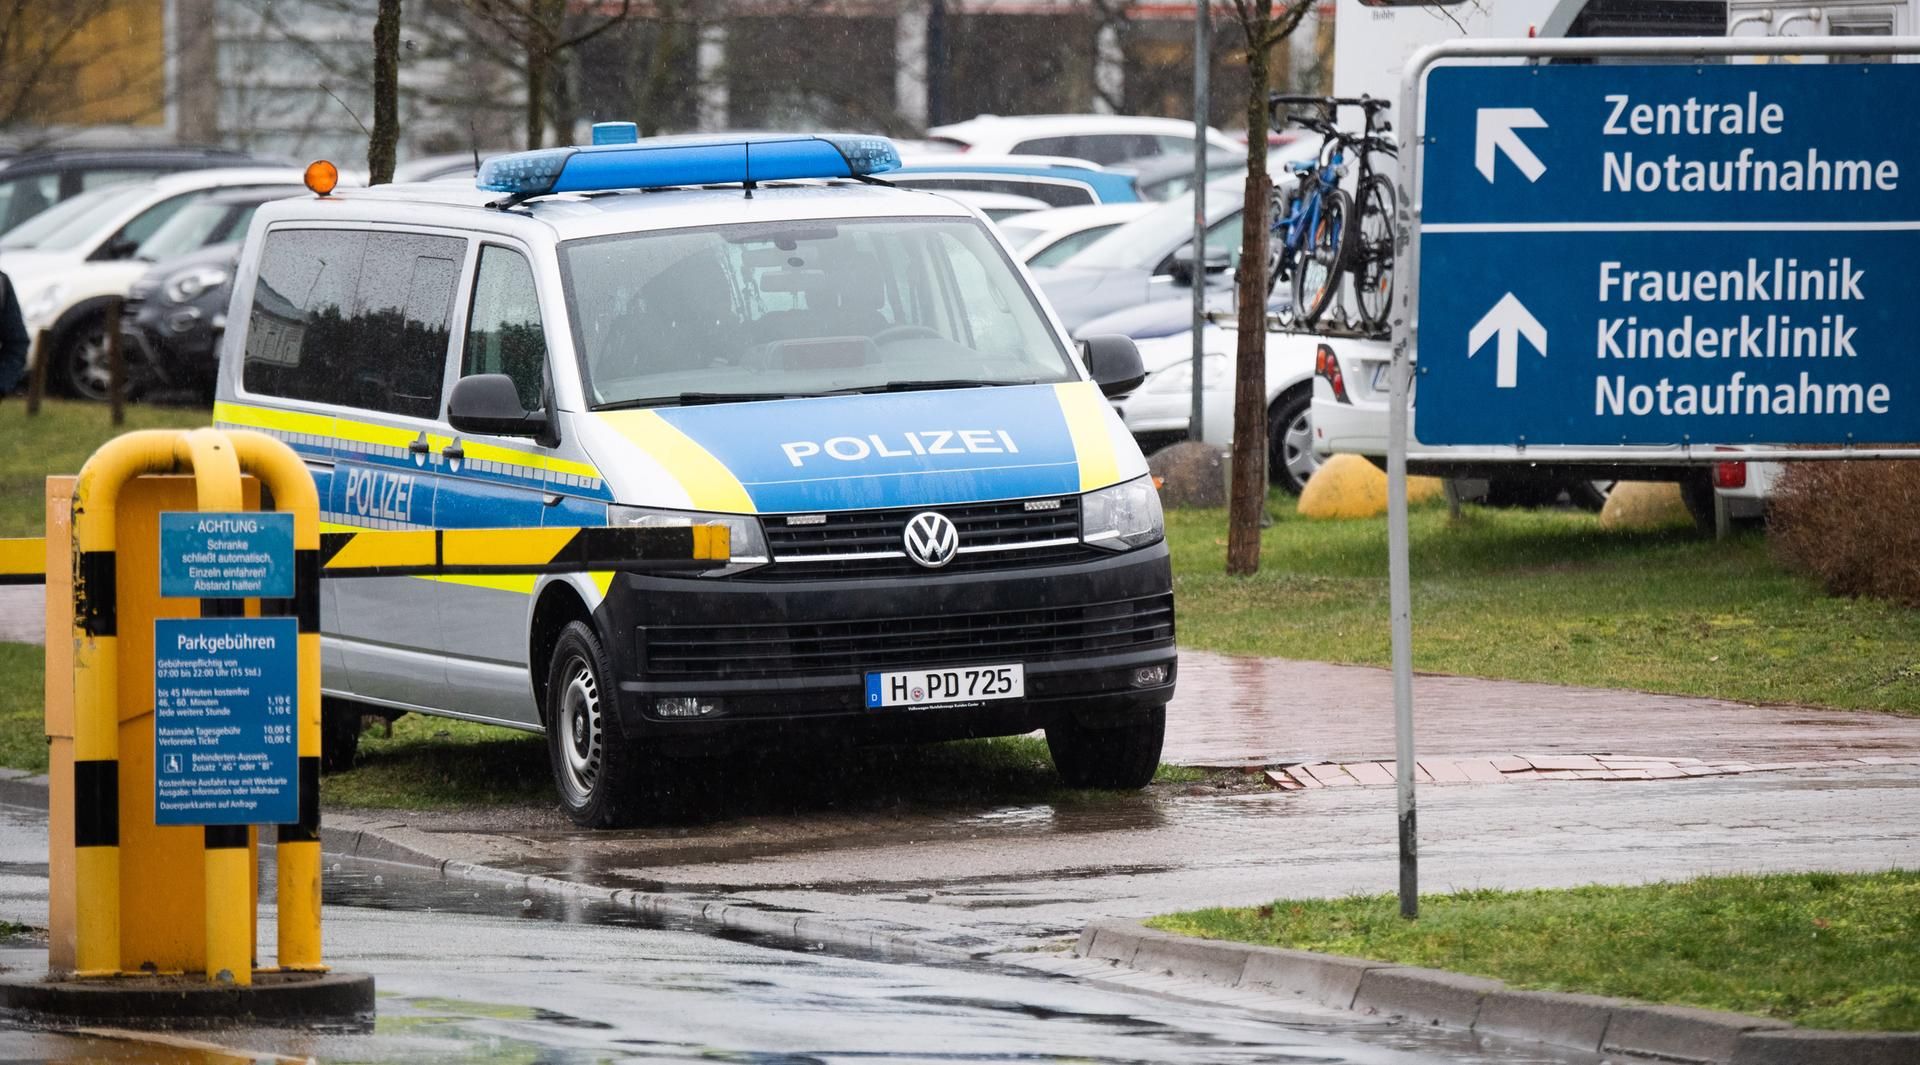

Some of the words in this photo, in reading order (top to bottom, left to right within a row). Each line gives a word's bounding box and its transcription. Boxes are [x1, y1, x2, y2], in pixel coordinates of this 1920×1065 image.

[1602, 91, 1784, 135] Zentrale
[1602, 148, 1899, 192] Notaufnahme
[1599, 258, 1866, 302] Frauenklinik
[1597, 314, 1858, 359] Kinderklinik
[1595, 371, 1890, 416] Notaufnahme
[780, 430, 1020, 468] POLIZEI
[346, 468, 415, 521] POLIZEI
[198, 520, 258, 533] ACHTUNG
[208, 540, 248, 550] Schranke
[904, 512, 958, 568] VW
[182, 554, 216, 564] schließt
[189, 568, 221, 578] Einzeln
[223, 567, 266, 578] einfahren!
[194, 580, 230, 590] Abstand
[232, 580, 262, 590] halten!
[178, 634, 276, 654] Parkgebühren
[158, 660, 222, 669] Gebührenpflichtig
[158, 670, 179, 678] 07:00
[180, 669, 191, 677] bis
[193, 669, 214, 677] 22:00
[216, 668, 228, 676] Uhr
[230, 668, 242, 678] (15
[244, 668, 262, 677] Std.)
[872, 694, 878, 702] D
[891, 676, 908, 701] H
[926, 672, 959, 698] PD
[965, 668, 1012, 696] 725
[158, 688, 168, 697] bis
[170, 688, 180, 697] 45
[182, 688, 212, 696] Minuten
[214, 688, 250, 696] kostenfrei
[190, 698, 218, 706] Minuten
[158, 708, 174, 717] Jede
[176, 708, 204, 716] weitere
[206, 708, 231, 716] Stunde
[158, 728, 194, 736] Maximale
[196, 727, 241, 736] Tagesgebühr
[264, 726, 284, 734] 10,00
[286, 726, 291, 734] €
[158, 738, 196, 746] Verlorenes
[264, 736, 284, 744] 10,00
[286, 736, 291, 744] €
[192, 754, 268, 762] Behinderten-Ausweis
[192, 763, 216, 772] Zusatz
[239, 762, 256, 770] oder
[158, 780, 197, 788] Kostenfreie
[198, 778, 227, 786] Ausfahrt
[242, 778, 253, 786] mit
[254, 777, 288, 785] Wertkarte
[160, 789, 190, 798] Ausgabe:
[192, 788, 232, 796] Information
[233, 787, 248, 795] oder
[250, 786, 279, 794] Infohaus
[160, 800, 216, 810] Dauerparkkarten
[218, 800, 230, 808] auf
[230, 800, 257, 810] Anfrage
